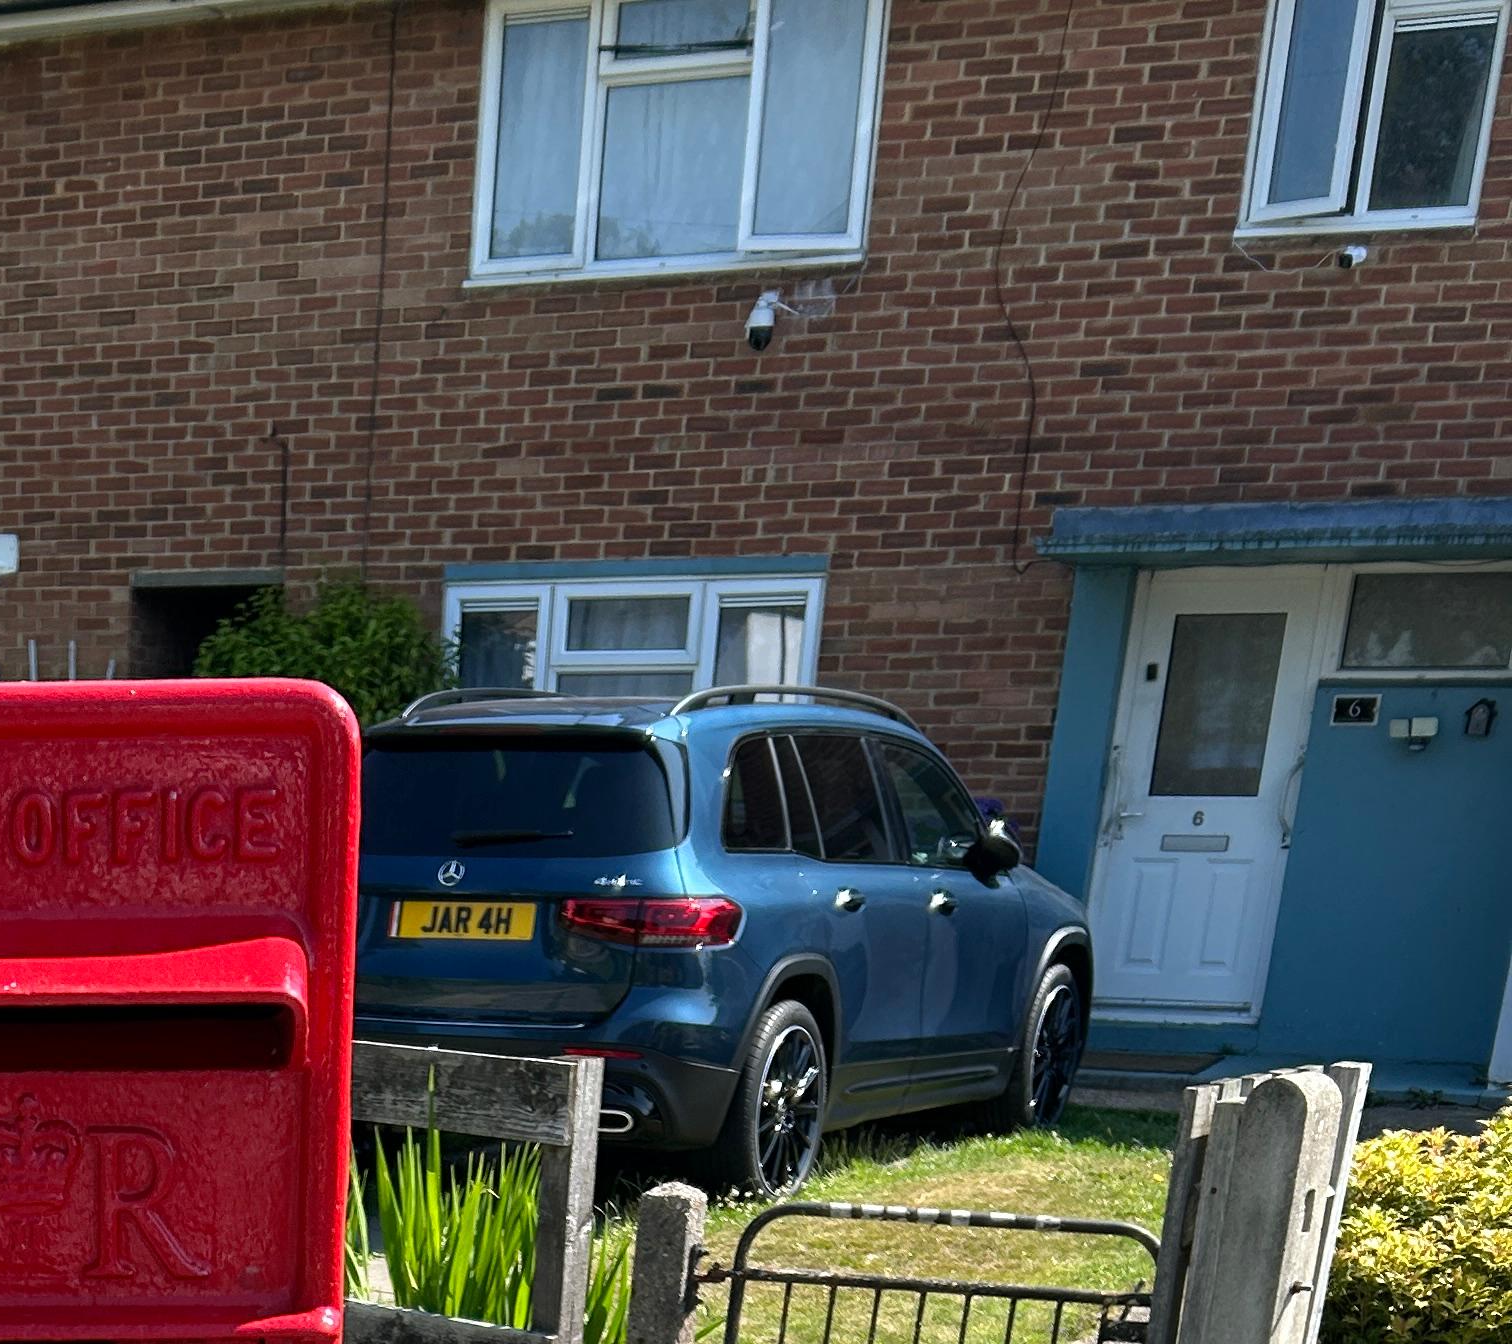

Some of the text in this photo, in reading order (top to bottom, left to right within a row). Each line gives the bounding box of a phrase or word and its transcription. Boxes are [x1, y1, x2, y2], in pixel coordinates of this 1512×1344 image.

[1348, 699, 1361, 718] 6
[8, 785, 281, 867] OFFICE
[1192, 810, 1205, 826] 6
[420, 906, 514, 935] JAR 4H
[84, 1125, 211, 1280] R
